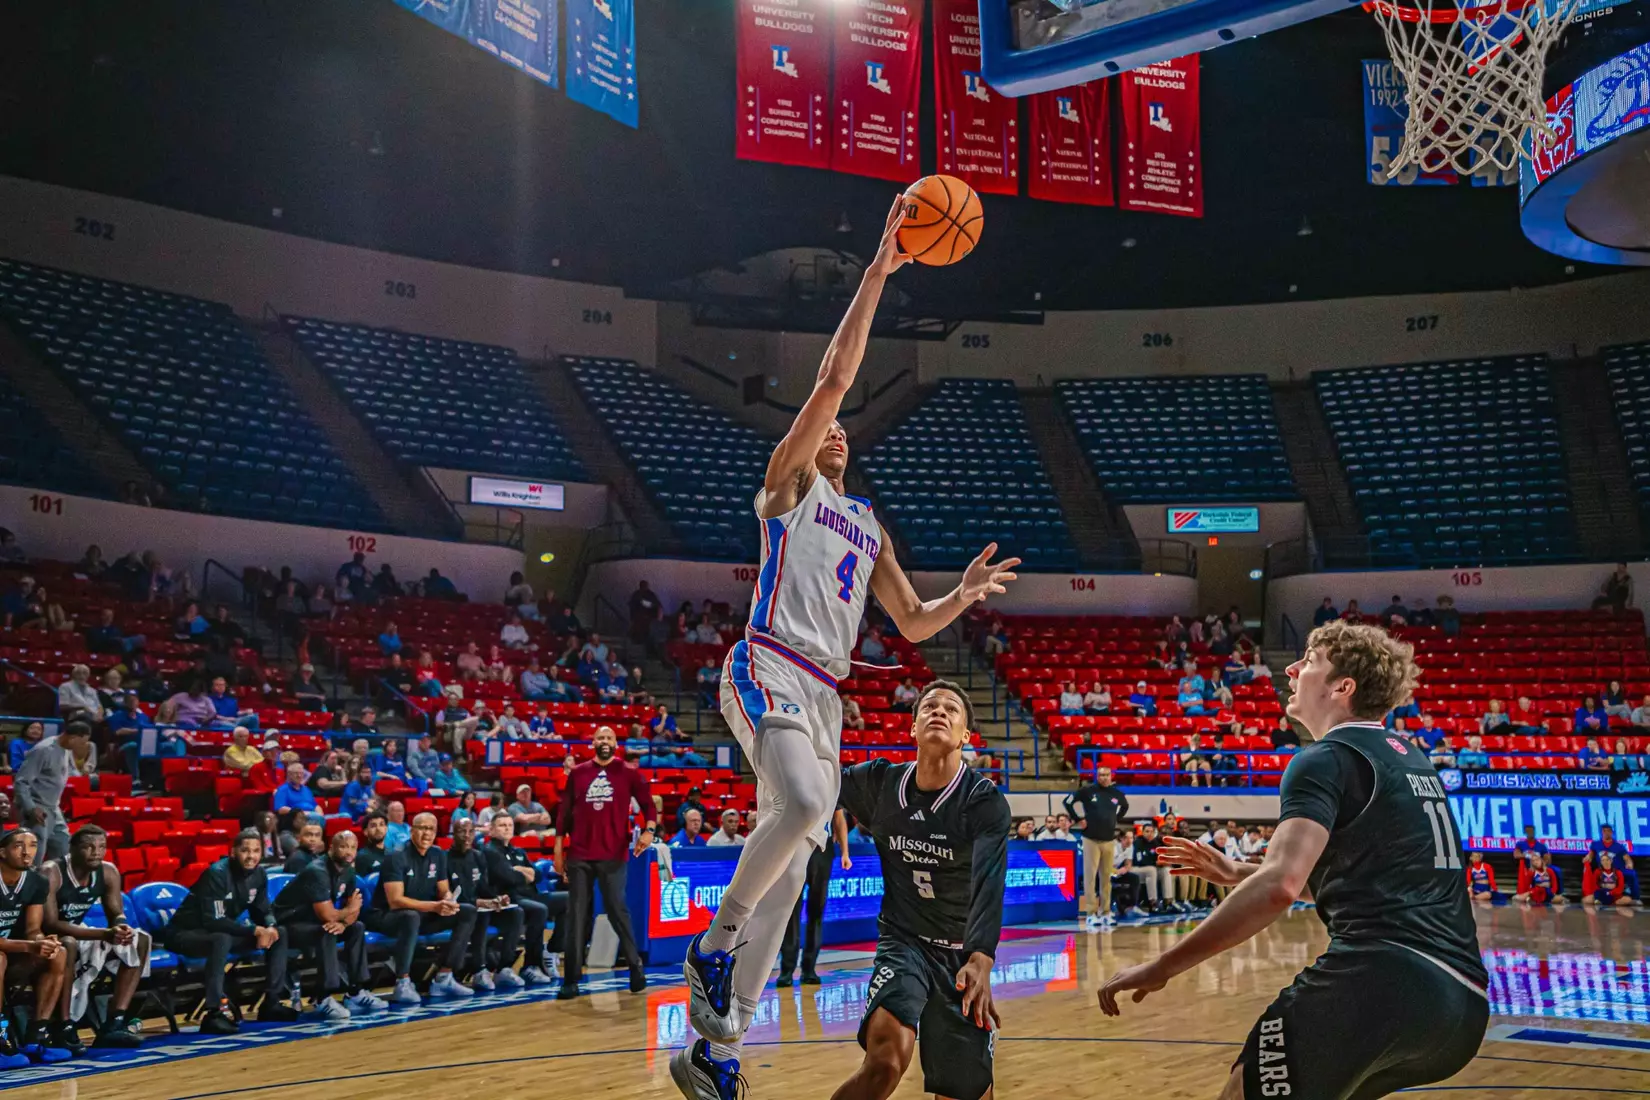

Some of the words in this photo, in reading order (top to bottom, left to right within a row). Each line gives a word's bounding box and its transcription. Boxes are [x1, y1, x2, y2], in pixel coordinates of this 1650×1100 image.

[753, 4, 815, 20] UNIVERSITY
[866, 12, 893, 24] TECH
[755, 16, 813, 33] BULLDOGS
[849, 21, 909, 39] UNIVERSITY
[963, 25, 980, 35] TEC
[851, 34, 907, 51] BULLDOGS
[949, 35, 980, 45] UNIVER
[1134, 77, 1185, 89] BULLDOGS
[764, 127, 805, 139] CHAMPIONS
[857, 141, 897, 154] CHAMPIONS
[75, 217, 115, 241] 202
[384, 280, 415, 299] 203
[1406, 315, 1439, 331] 207
[961, 334, 990, 348] 205
[1143, 333, 1173, 347] 206
[29, 494, 62, 516] 101
[814, 502, 864, 551] LOUISIANA
[347, 535, 376, 553] 102
[732, 567, 759, 582] 103
[836, 550, 858, 604] 4
[1451, 572, 1482, 586] 105
[1070, 578, 1096, 591] 104
[1467, 773, 1560, 789] LOUISIANA
[1562, 774, 1611, 790] TECH
[1449, 797, 1650, 847] WELCOME
[1423, 801, 1462, 869] 11
[1472, 837, 1483, 848] TO
[1486, 837, 1501, 848] THE
[889, 835, 954, 861] Missouri
[846, 877, 859, 897] OF
[912, 870, 935, 898] 5
[1259, 1017, 1291, 1097] BEARS
